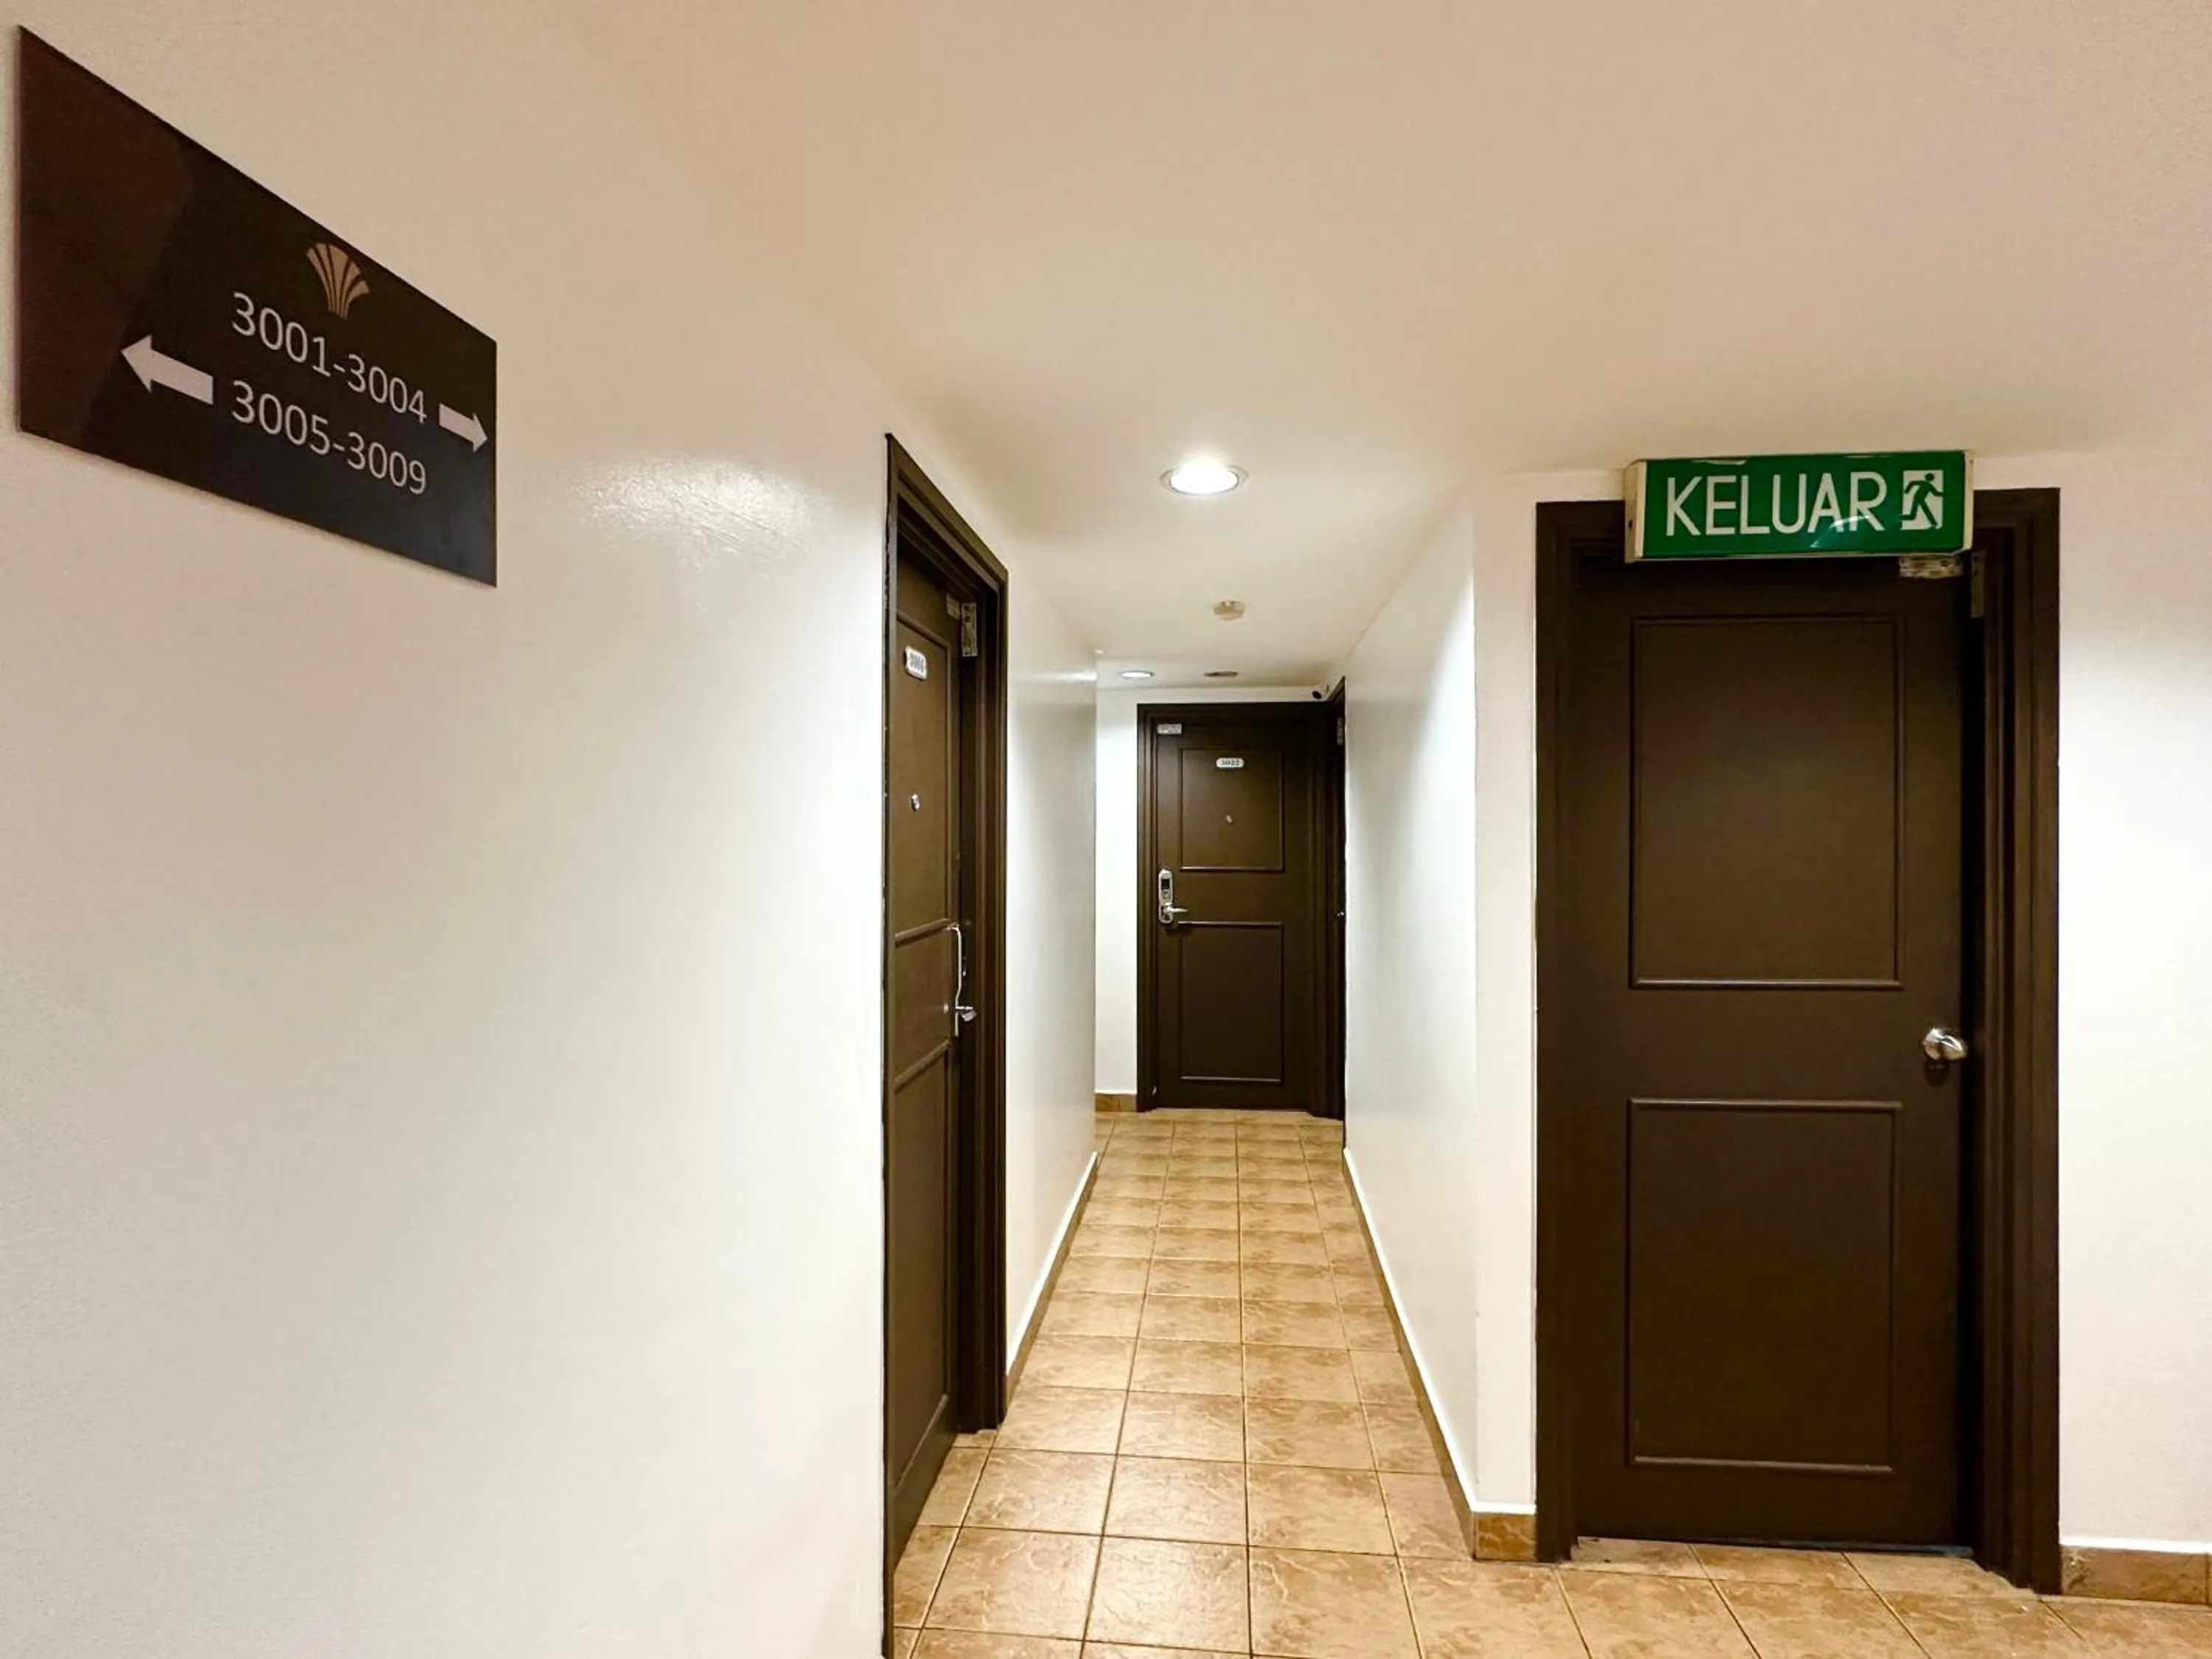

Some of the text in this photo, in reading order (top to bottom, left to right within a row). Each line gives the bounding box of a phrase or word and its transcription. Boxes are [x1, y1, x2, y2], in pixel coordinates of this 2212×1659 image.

[232, 292, 427, 424] 3001-3004
[232, 380, 427, 495] 3005-3009
[1666, 471, 1886, 536] KELUAR
